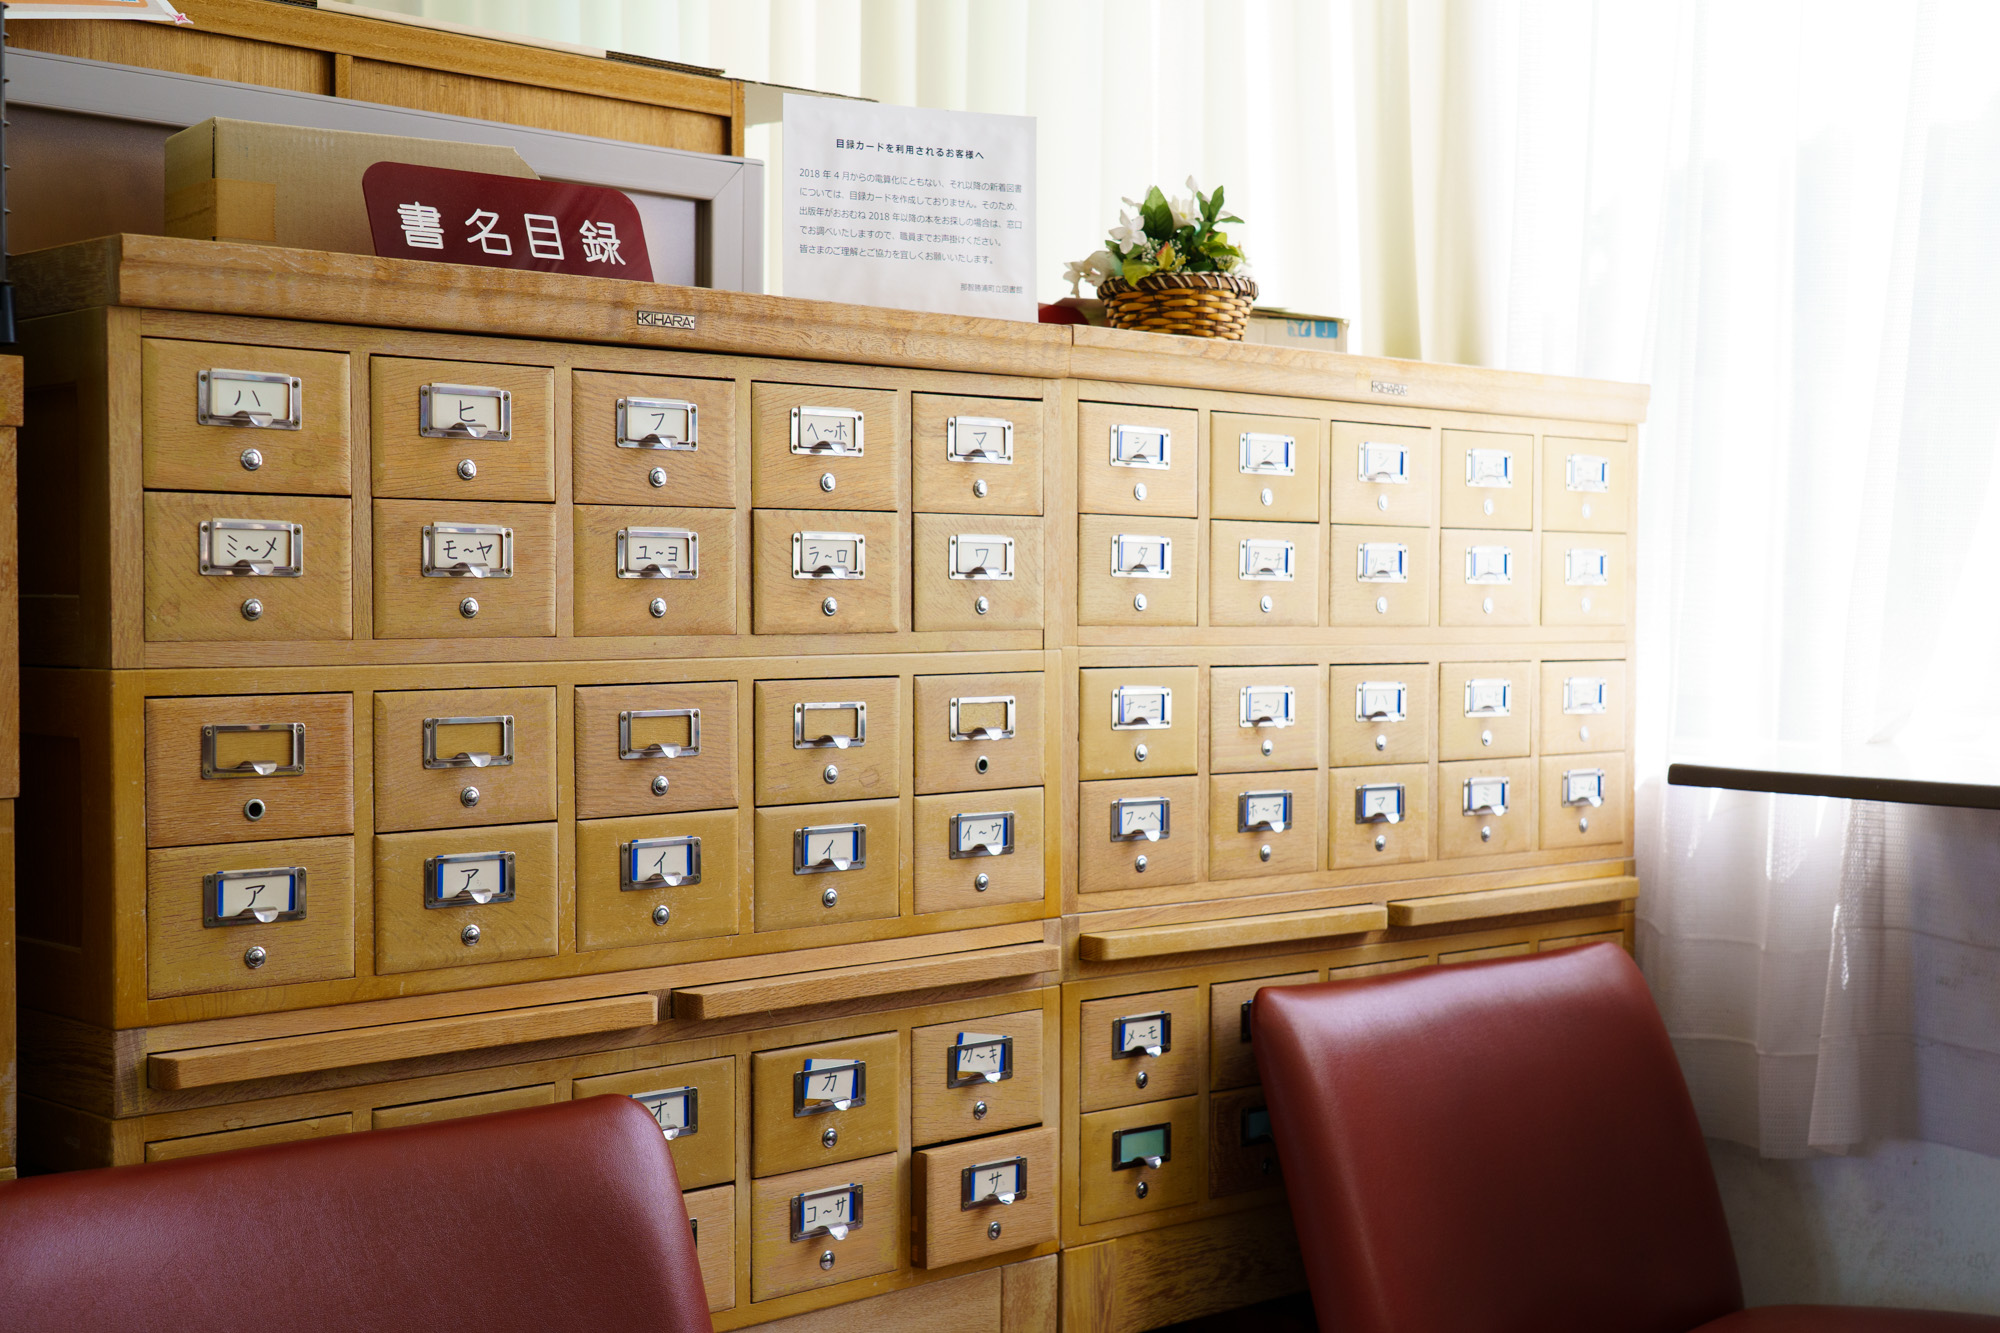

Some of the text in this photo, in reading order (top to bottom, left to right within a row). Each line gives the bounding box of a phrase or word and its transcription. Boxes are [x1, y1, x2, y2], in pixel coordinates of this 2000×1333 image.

[836, 139, 984, 160] 目録カードを利用されるお客様へ
[397, 201, 626, 266] 書名目録
[642, 313, 692, 328] KIHARA
[234, 390, 261, 407] ハ
[459, 400, 476, 422] ヒ
[651, 413, 665, 430] フ
[973, 432, 987, 448] マ
[976, 548, 989, 567] ワ
[822, 840, 834, 859] イ
[654, 852, 666, 873] イ
[460, 868, 479, 890] ア
[245, 884, 266, 906] ア
[822, 1072, 838, 1092] カ
[650, 1100, 668, 1122] オ
[988, 1172, 1003, 1193] サ
